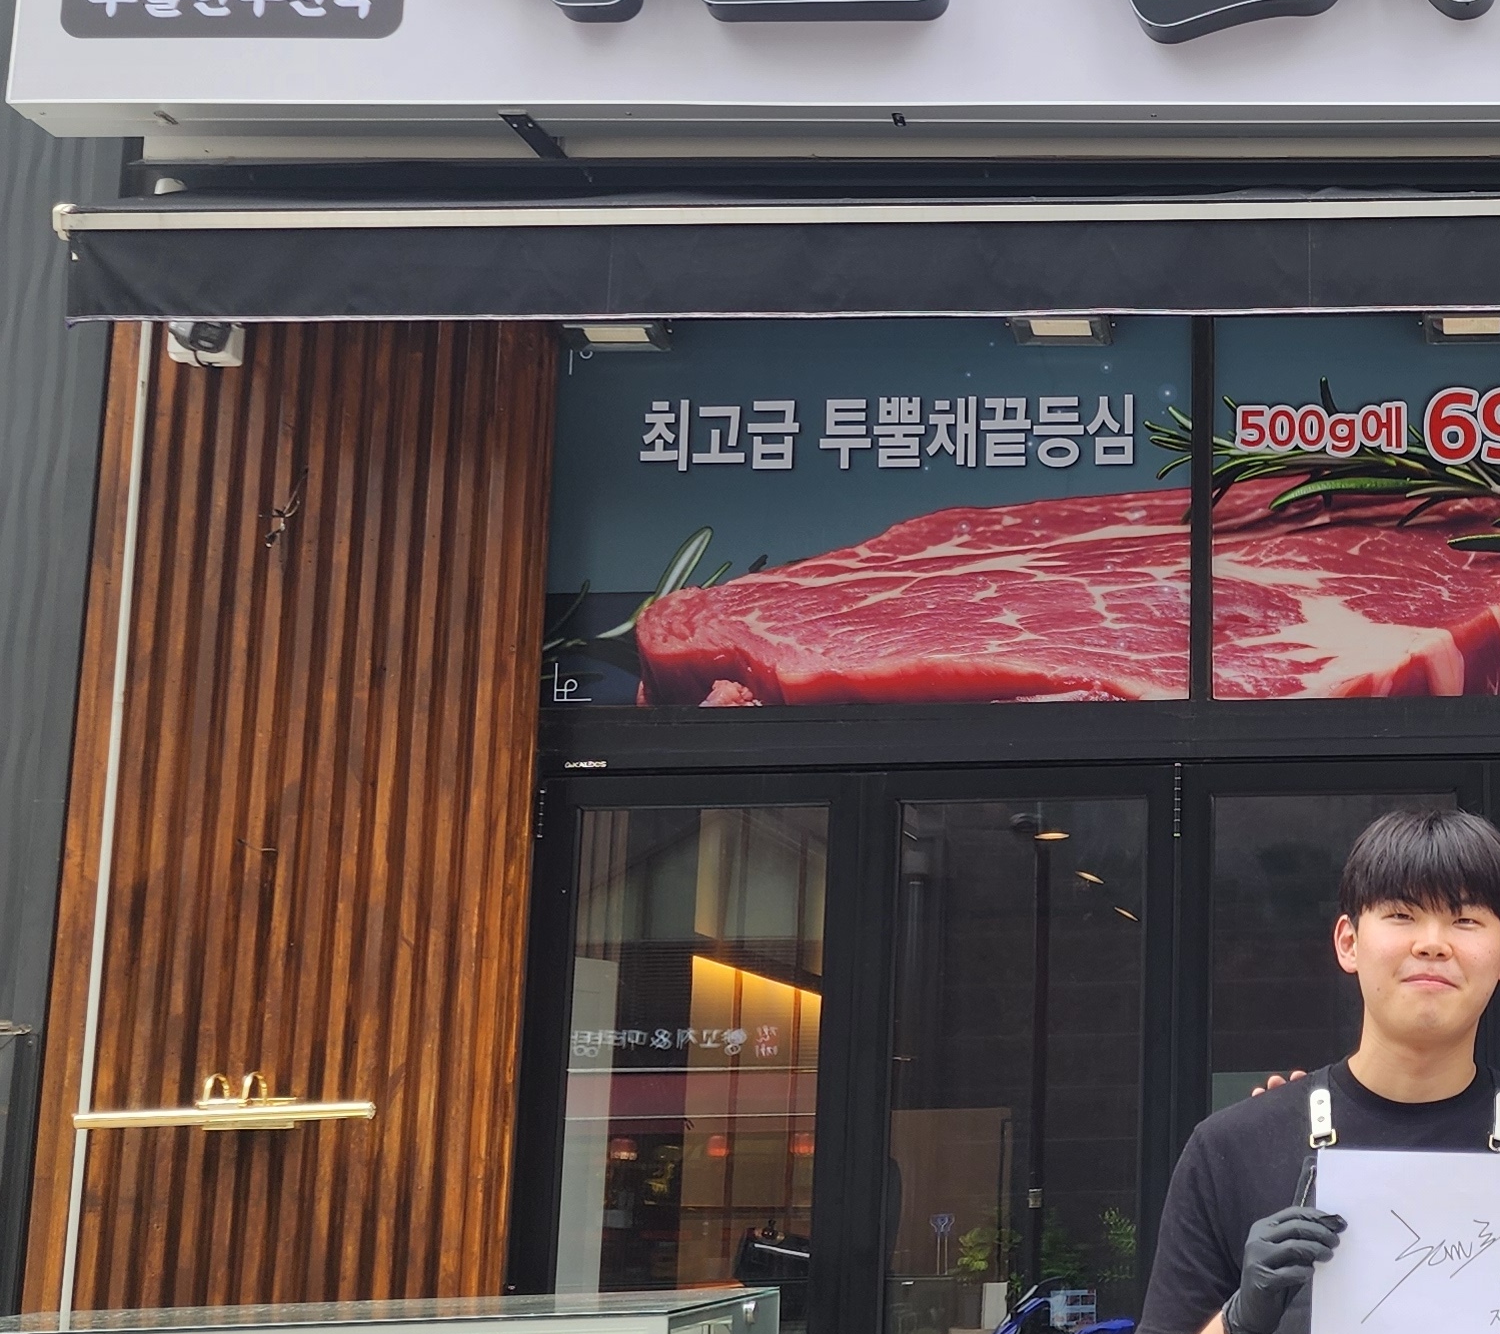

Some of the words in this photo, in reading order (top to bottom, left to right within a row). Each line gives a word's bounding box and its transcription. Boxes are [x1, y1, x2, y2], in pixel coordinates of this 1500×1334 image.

[639, 398, 800, 472] 최고급
[818, 393, 1136, 470] 투뿔채끝등심
[1234, 400, 1408, 457] 500g에
